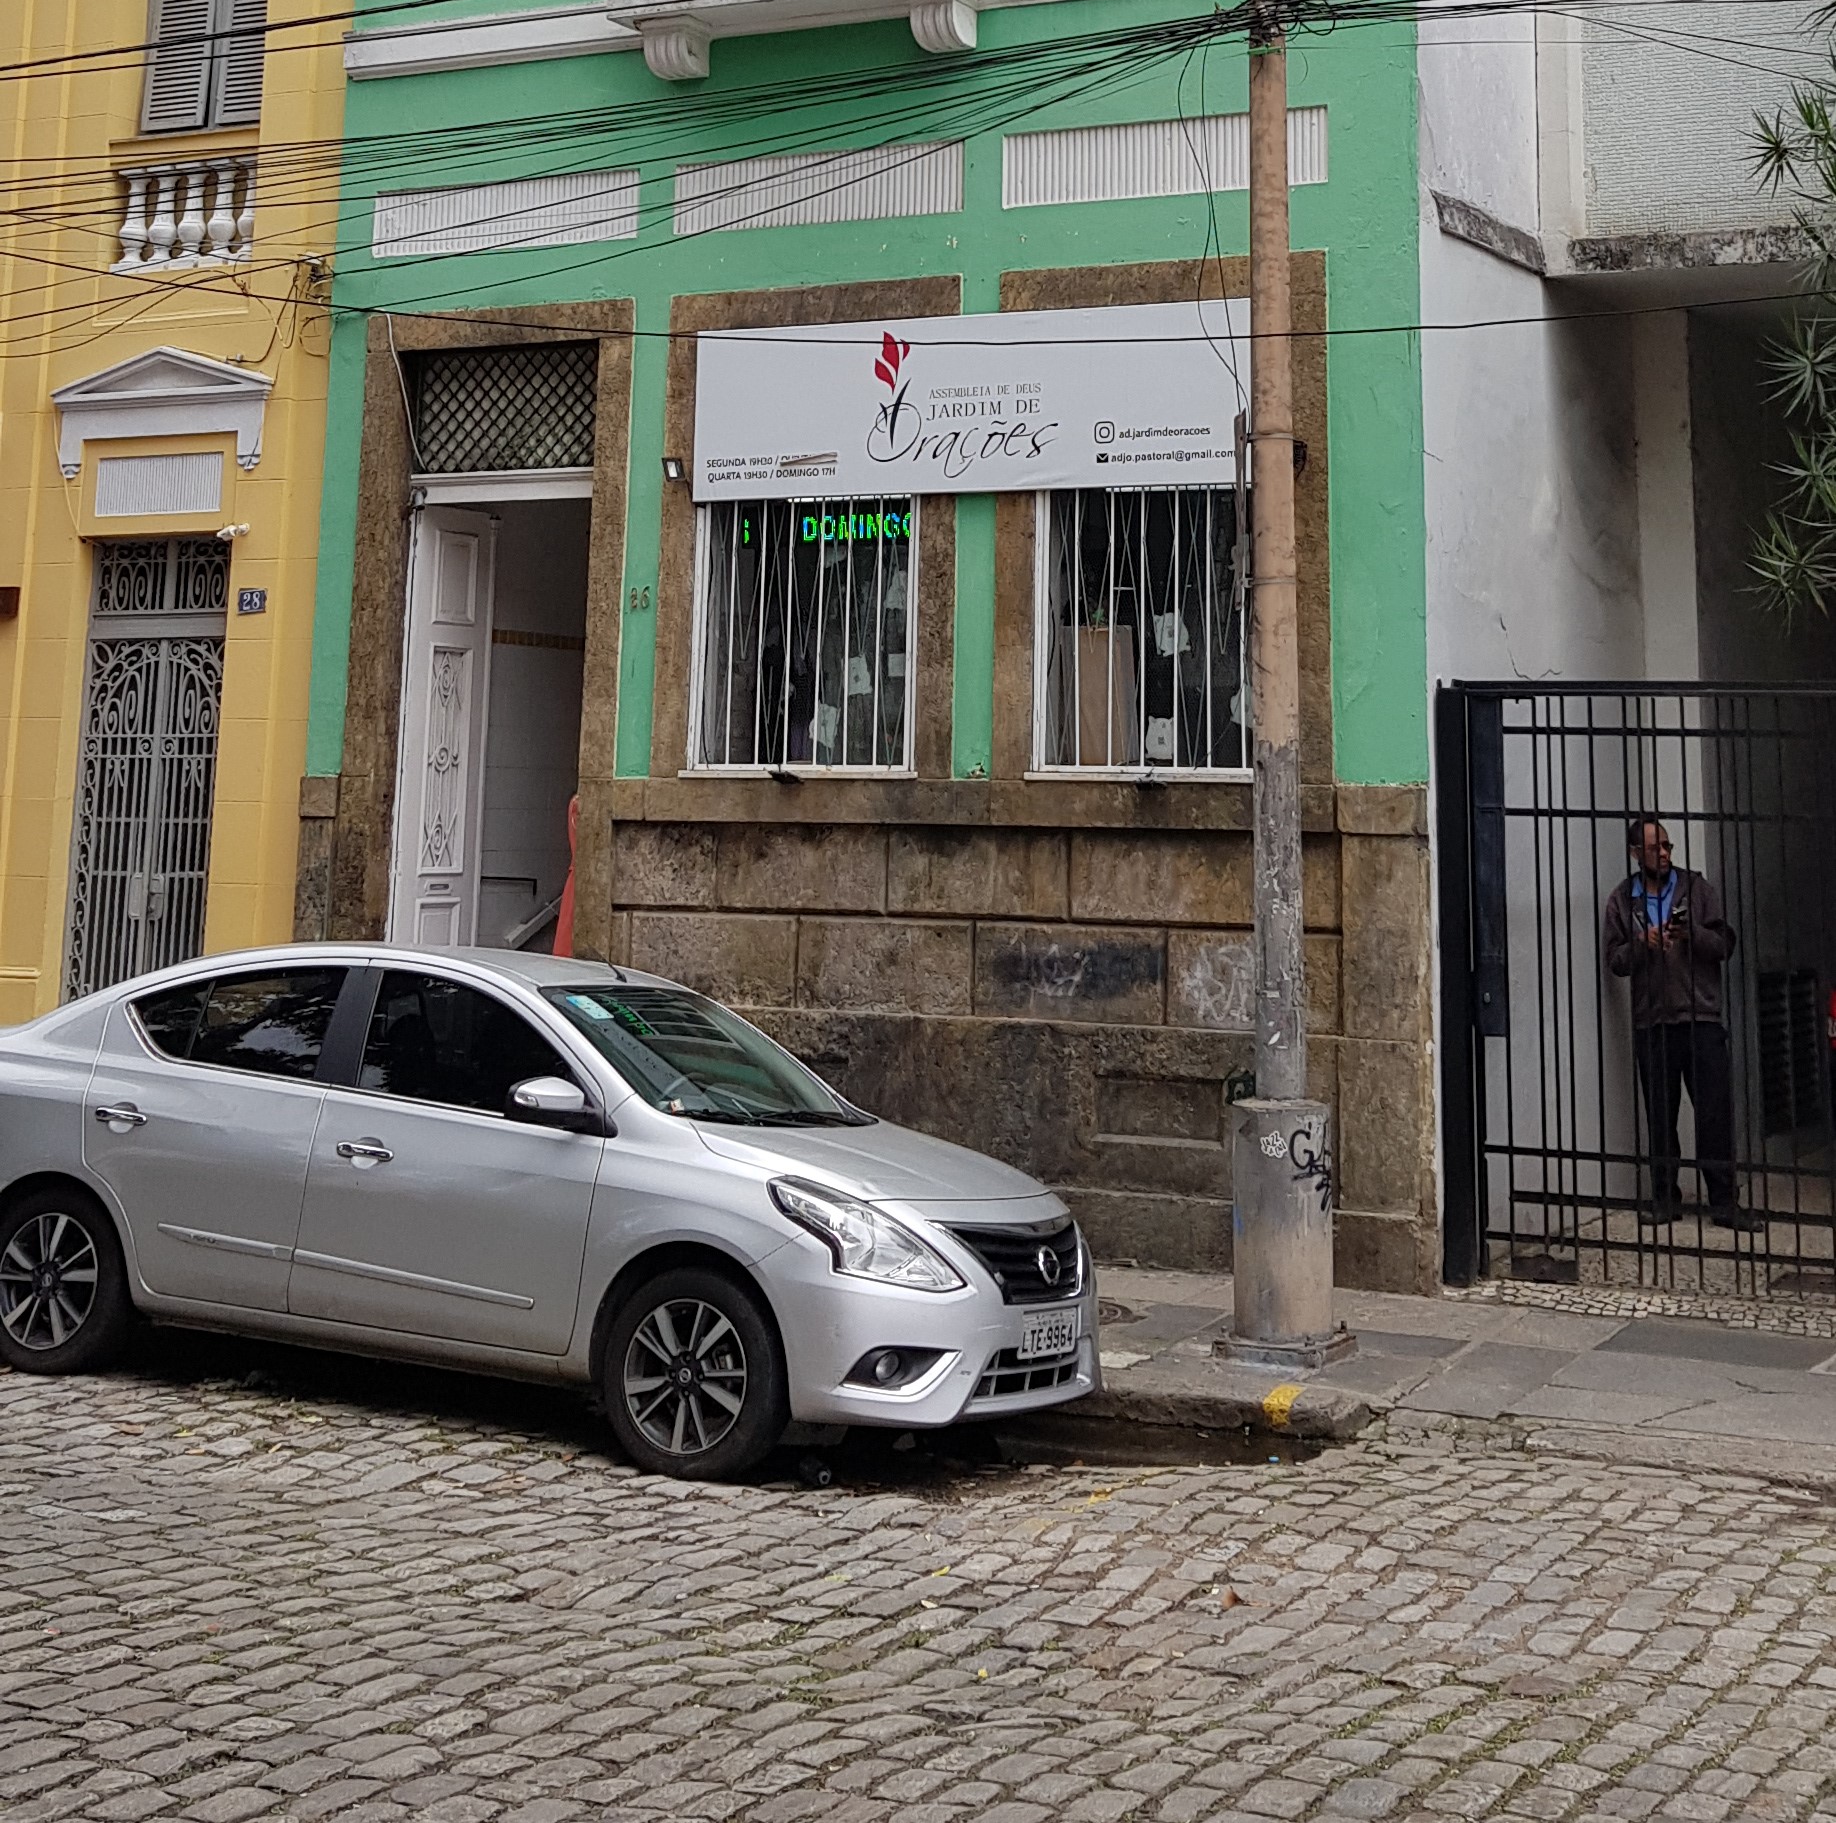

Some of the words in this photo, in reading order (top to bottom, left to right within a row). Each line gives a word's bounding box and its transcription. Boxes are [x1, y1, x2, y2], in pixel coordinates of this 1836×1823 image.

[929, 385, 991, 399] ASSEMBLEIA
[997, 384, 1010, 395] DE
[1015, 382, 1041, 394] DEUS
[926, 400, 1002, 421] JARDIM
[1015, 398, 1041, 415] DE
[866, 400, 1059, 479] Orações
[1118, 426, 1211, 441] ad.jardimdeoracoes
[706, 457, 746, 468] SEGUNDA
[749, 456, 773, 466] 19H30
[707, 471, 741, 483] QUARTA
[743, 470, 768, 480] 19H30
[775, 467, 819, 478] DOMINGO
[821, 466, 836, 476] 17H
[242, 591, 260, 611] 28
